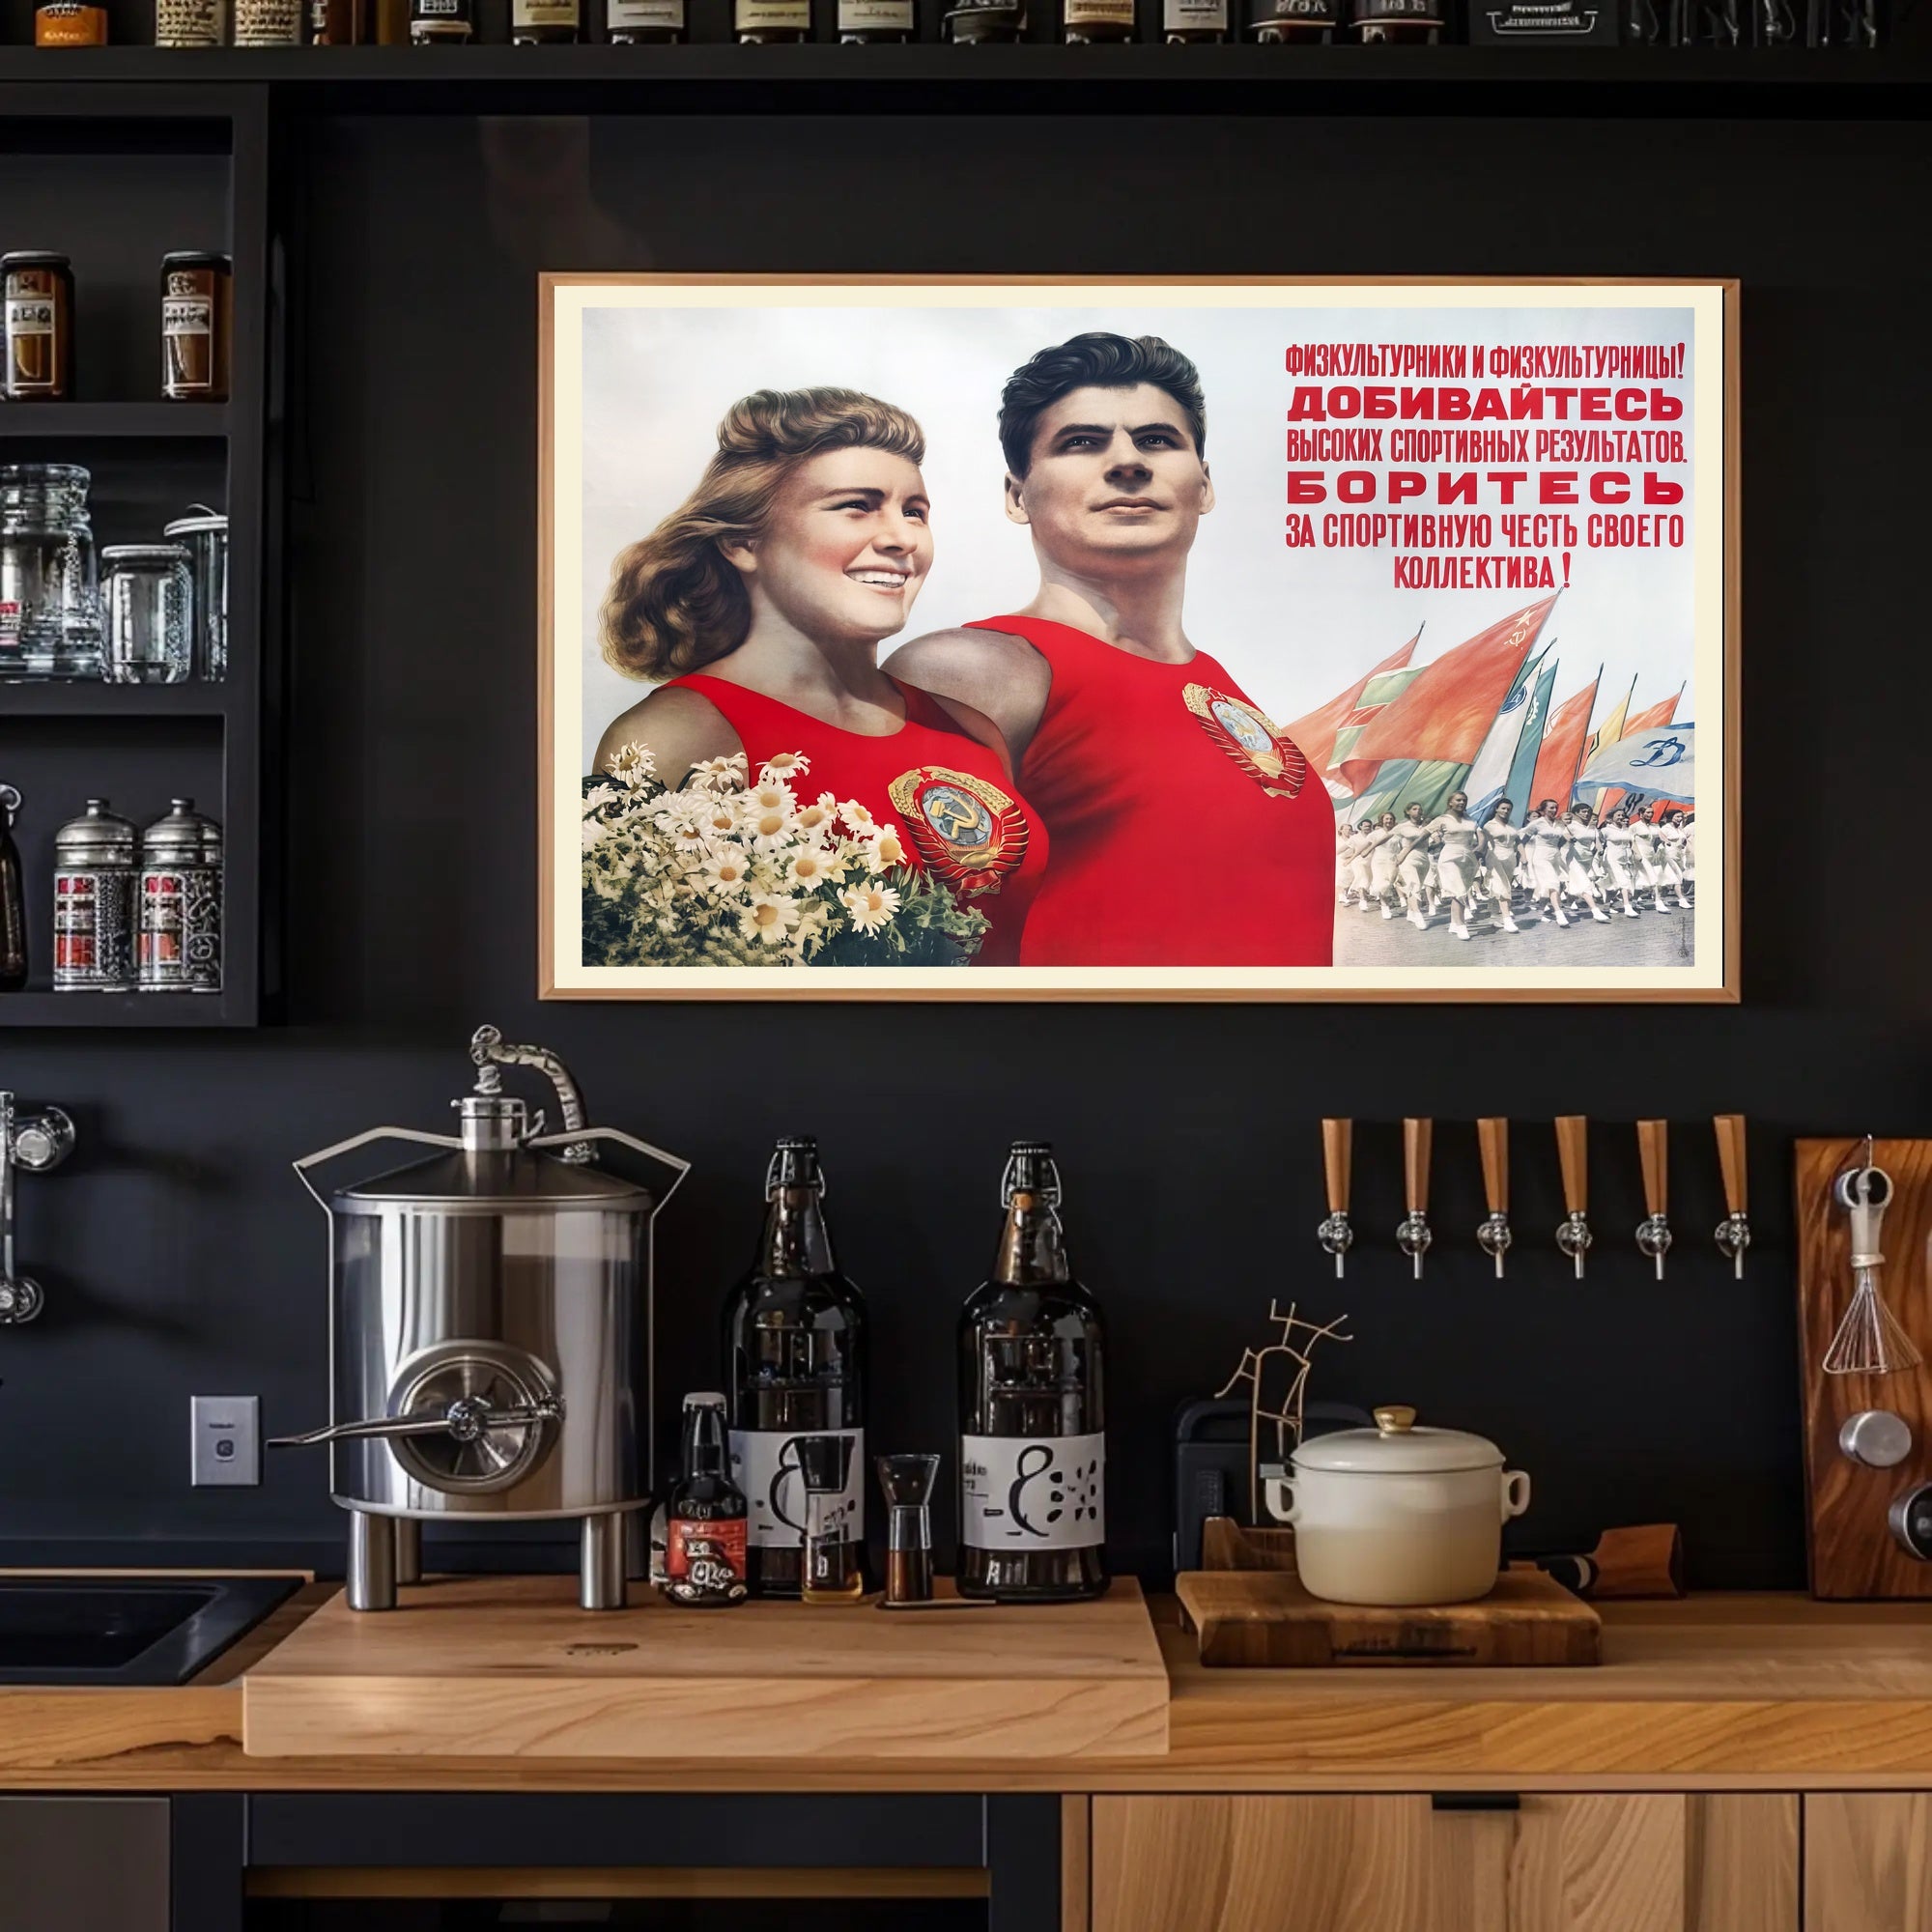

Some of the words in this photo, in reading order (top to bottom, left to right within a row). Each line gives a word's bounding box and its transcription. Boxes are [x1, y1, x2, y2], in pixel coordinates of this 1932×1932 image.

[1286, 344, 1466, 378] ФИЗКУЛЬТУРНИКИ
[1472, 346, 1484, 378] И
[1490, 343, 1685, 379] ФИЗКУЛЬТУРНИЦЫ!
[1288, 383, 1683, 421] ДОБИВАЙТЕСЬ
[1287, 429, 1382, 462] ВЫСОКИХ
[1391, 429, 1528, 463] СПОРТИВНЫХ
[1536, 429, 1687, 463] РЕЗУЛЬТАТОВ.
[1287, 470, 1684, 505] БОРИТЕСЬ
[1286, 514, 1316, 548] ЗА
[1323, 514, 1492, 548] СПОРТИВНУЮ
[1501, 514, 1577, 548] ЧЕСТЬ
[1588, 514, 1684, 548] СВОЕГО
